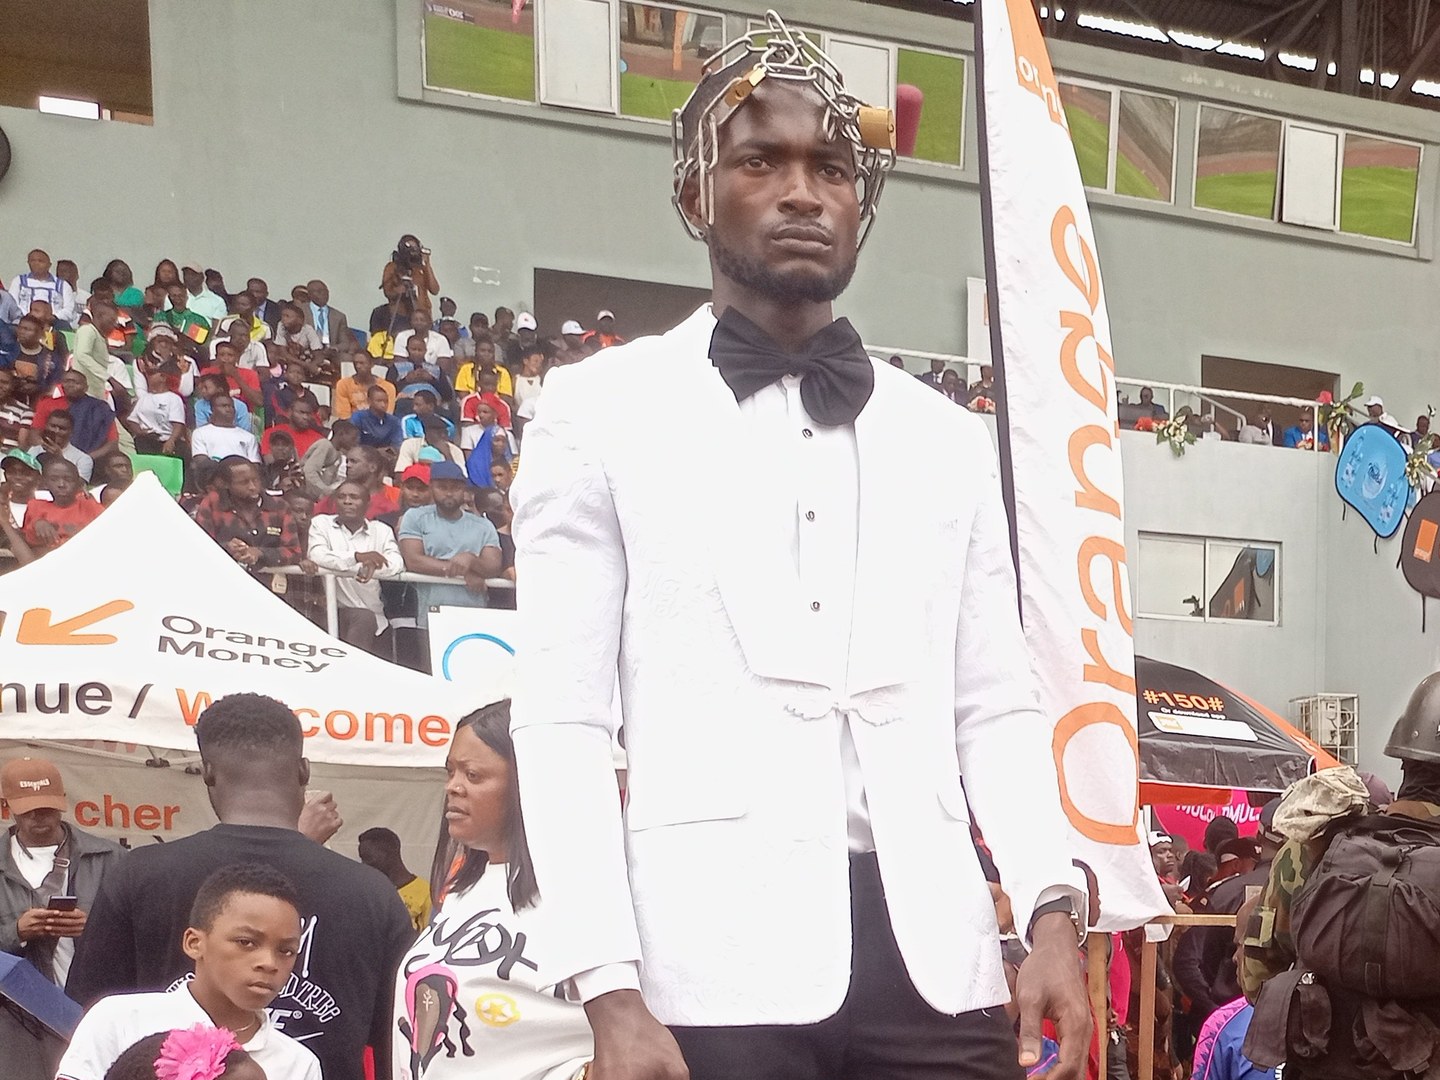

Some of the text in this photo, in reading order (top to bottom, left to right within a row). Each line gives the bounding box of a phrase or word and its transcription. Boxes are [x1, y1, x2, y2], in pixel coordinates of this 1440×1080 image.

[158, 635, 331, 673] Money
[161, 615, 348, 658] Orange
[1143, 689, 1223, 711] #150#
